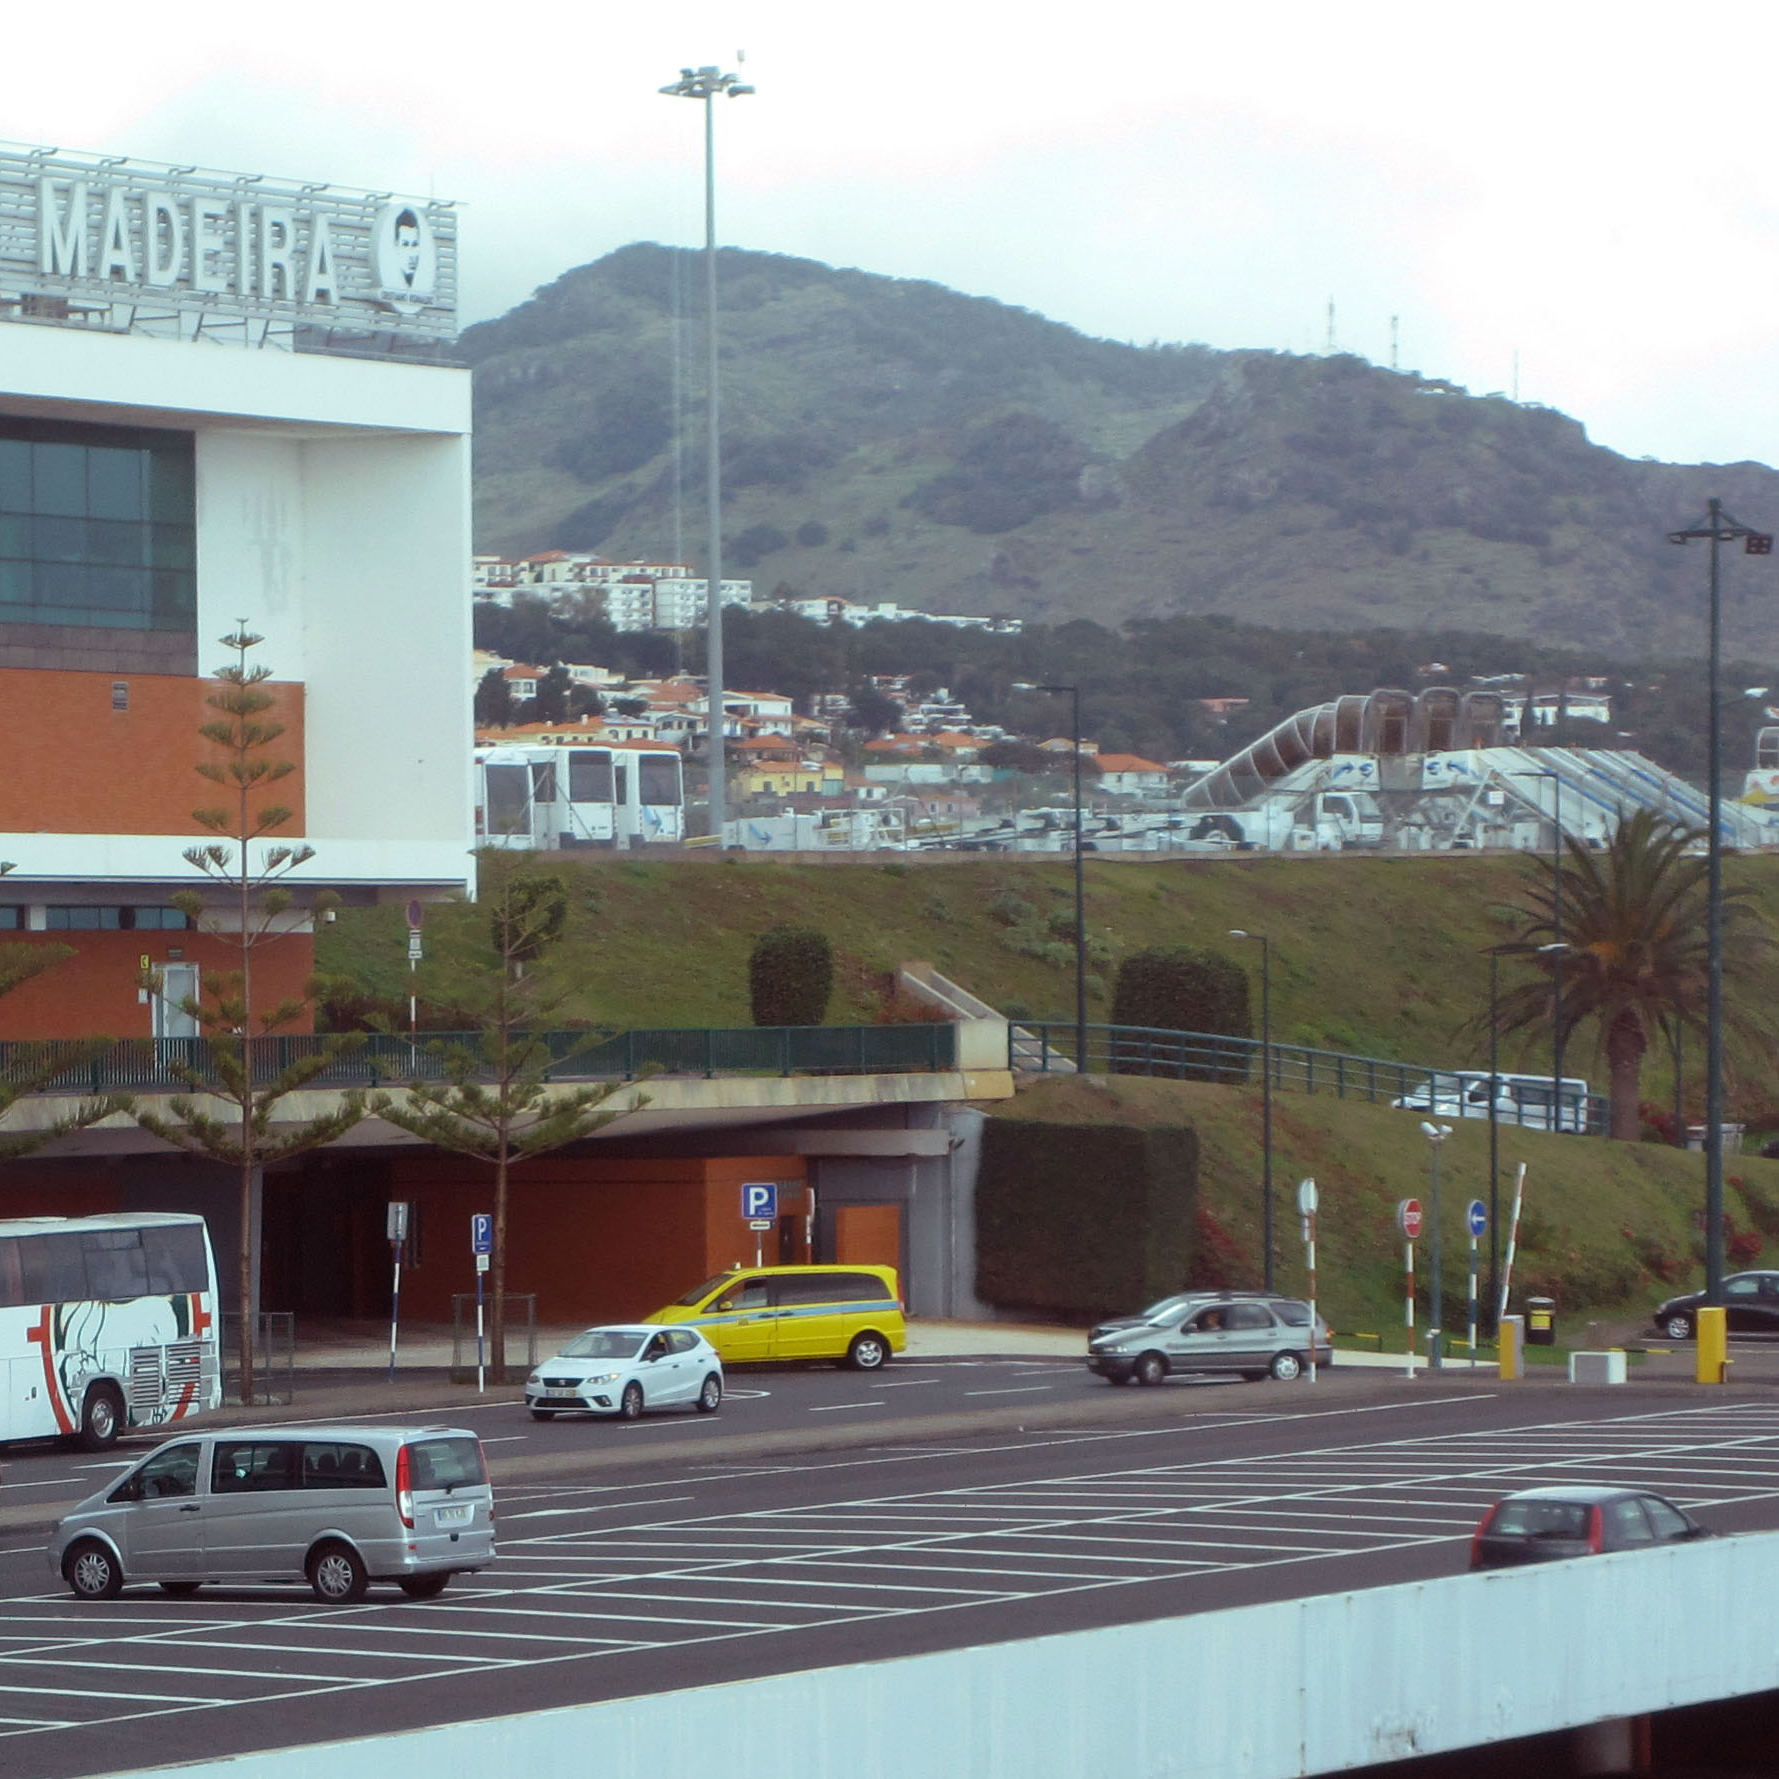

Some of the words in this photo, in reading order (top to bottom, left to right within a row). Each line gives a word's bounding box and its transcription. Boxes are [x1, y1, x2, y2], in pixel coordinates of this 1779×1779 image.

[38, 176, 341, 306] MADEIRA
[749, 1187, 769, 1216] P
[477, 1217, 487, 1241] P
